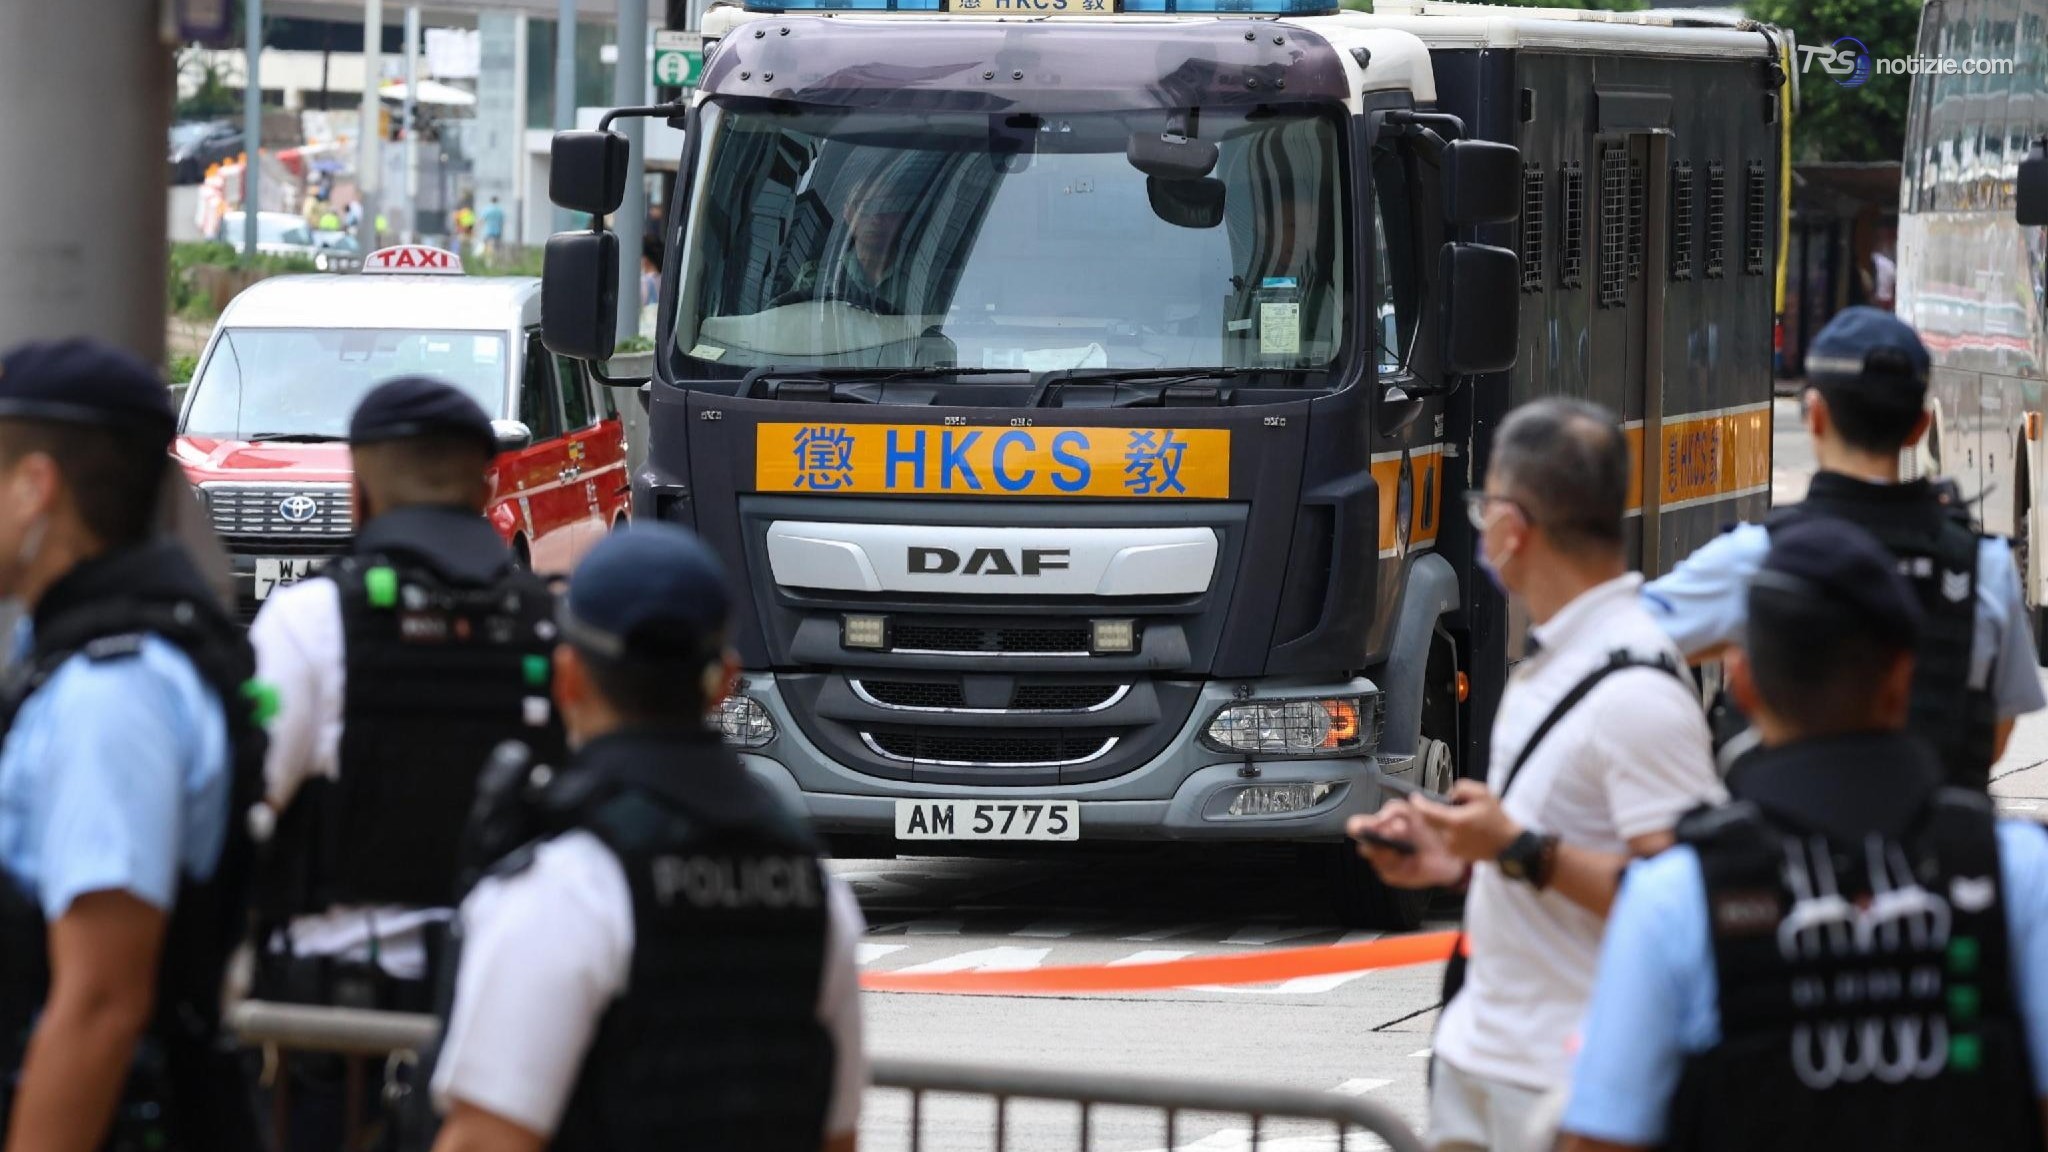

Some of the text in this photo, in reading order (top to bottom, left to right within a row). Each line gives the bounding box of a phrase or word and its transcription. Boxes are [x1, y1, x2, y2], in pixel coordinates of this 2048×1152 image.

[377, 248, 448, 268] TAXI
[793, 426, 855, 490] 懲
[885, 429, 1092, 492] HKCS
[907, 546, 1071, 575] DAF
[907, 804, 1068, 835] AM 5775
